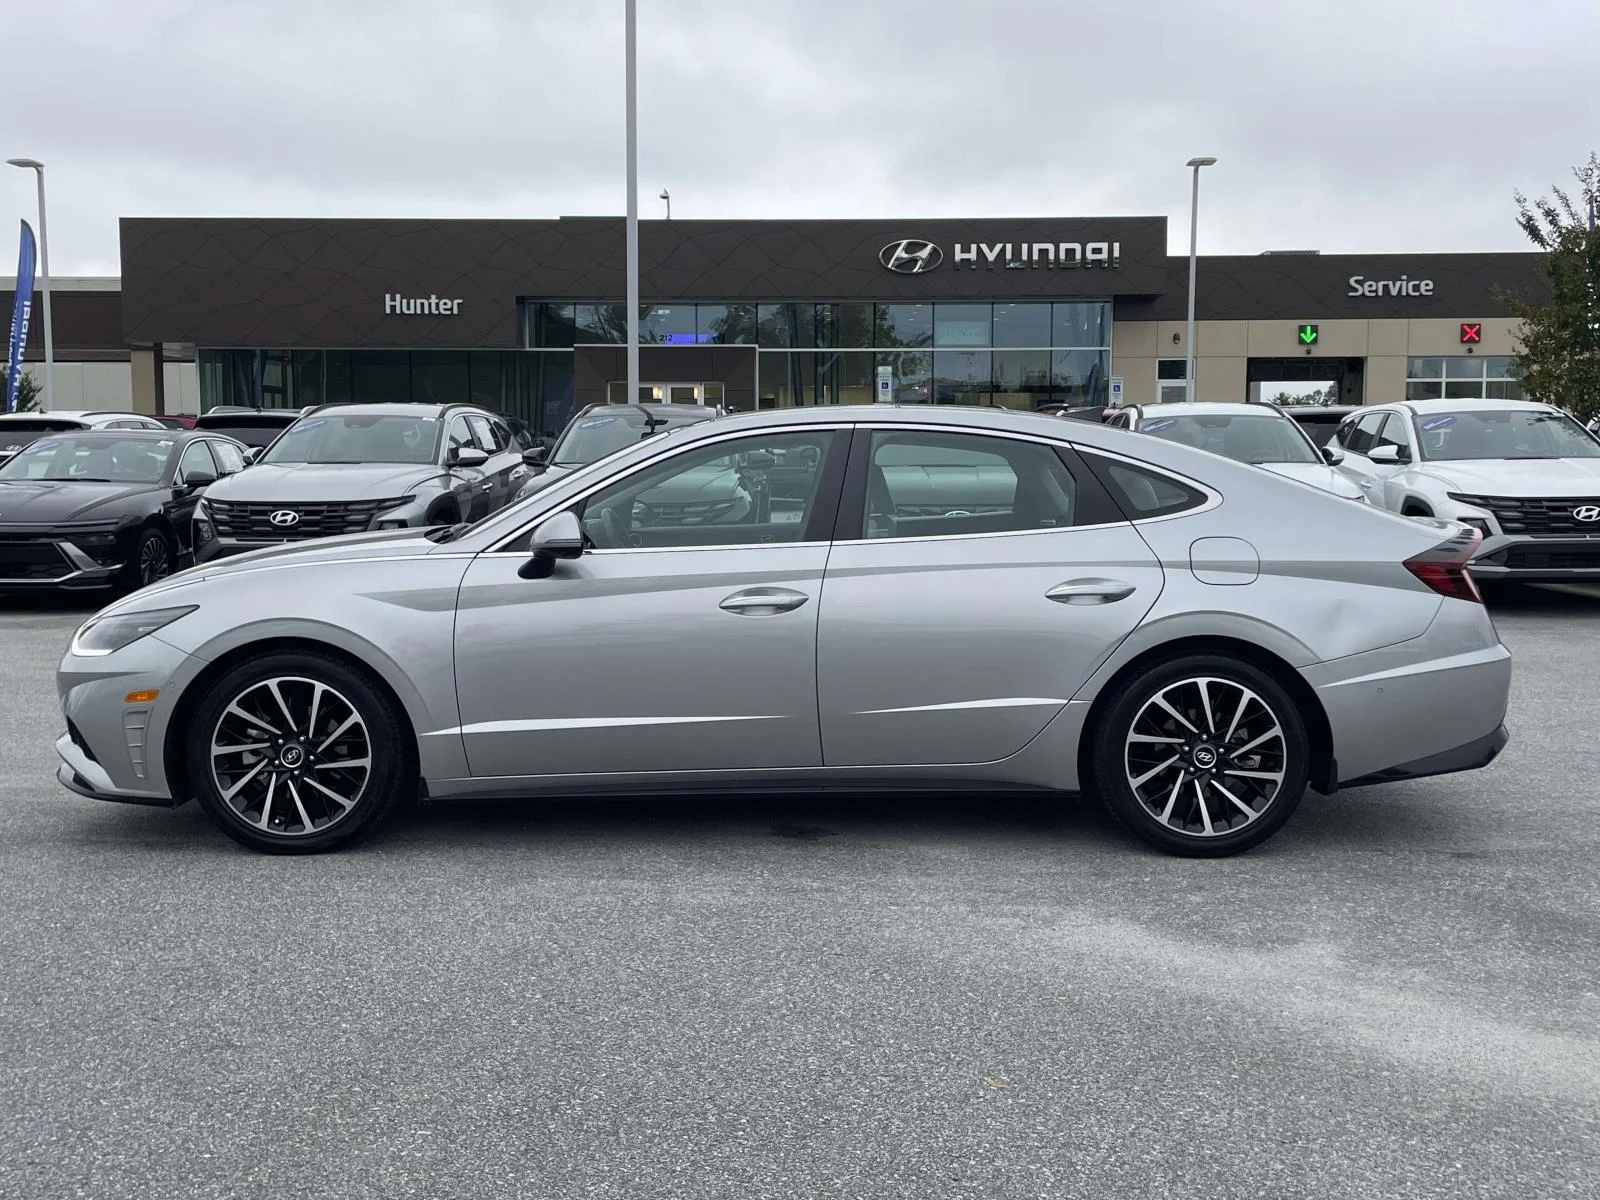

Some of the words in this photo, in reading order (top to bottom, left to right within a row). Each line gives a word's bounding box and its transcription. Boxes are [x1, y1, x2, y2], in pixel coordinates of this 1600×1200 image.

[954, 241, 1120, 270] HYUNDAI
[1348, 275, 1434, 296] Service
[385, 293, 464, 315] Hunter
